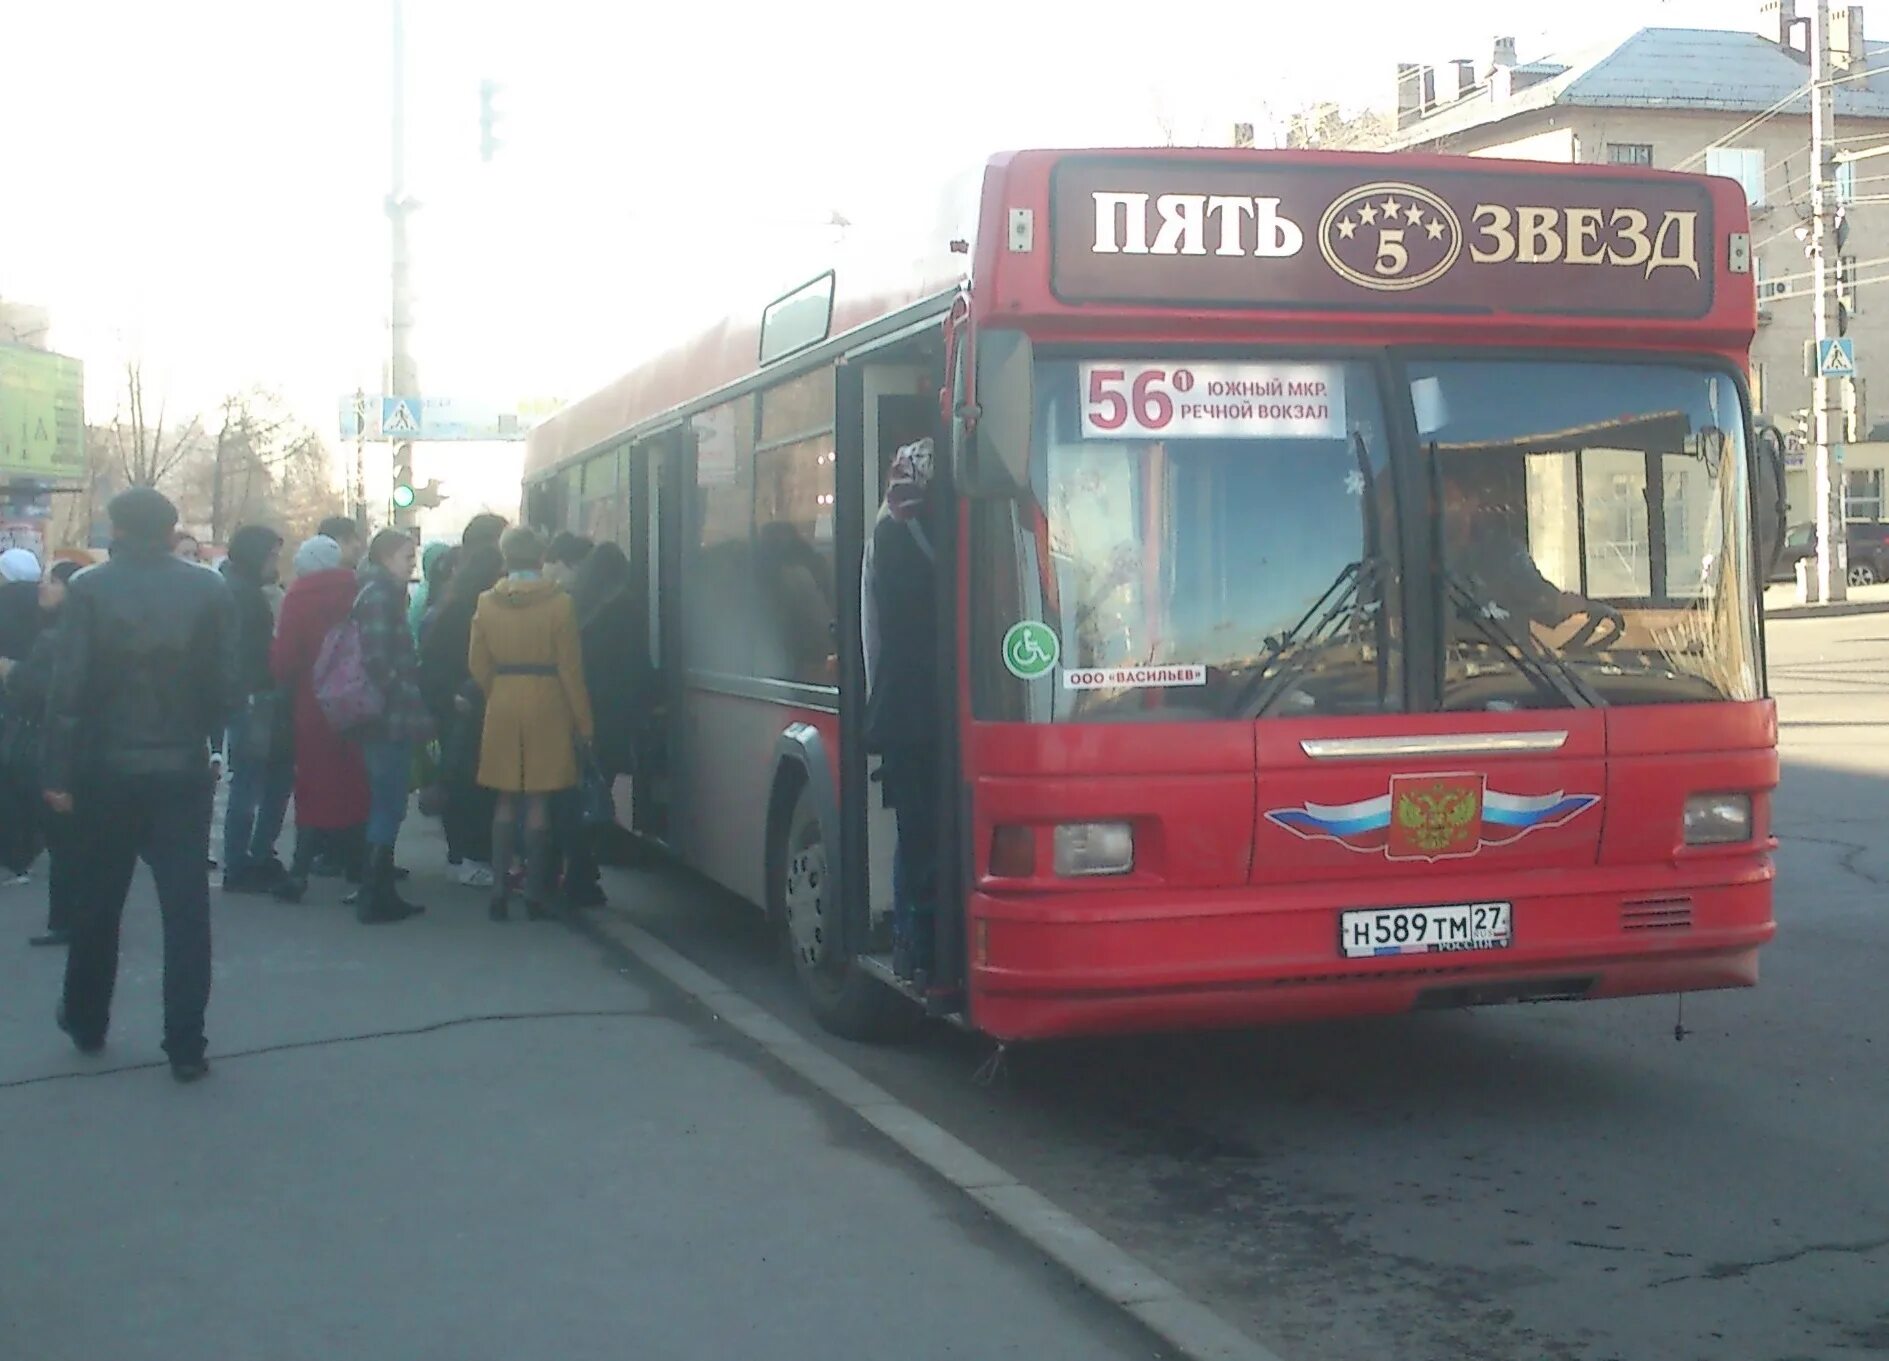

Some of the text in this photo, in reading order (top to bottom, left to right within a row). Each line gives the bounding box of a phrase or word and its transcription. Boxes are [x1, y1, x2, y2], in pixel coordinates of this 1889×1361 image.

[1091, 191, 1700, 281] ПЯТЬ 5 ЗВЕЗД
[1207, 378, 1328, 397] ЮЖНЫЙ МКР.
[1088, 369, 1174, 430] 56
[1180, 401, 1329, 420] РЕЧНОЙ ВОКЗАЛ
[1070, 669, 1201, 685] ООО «ВАСИЛЬЕВ»
